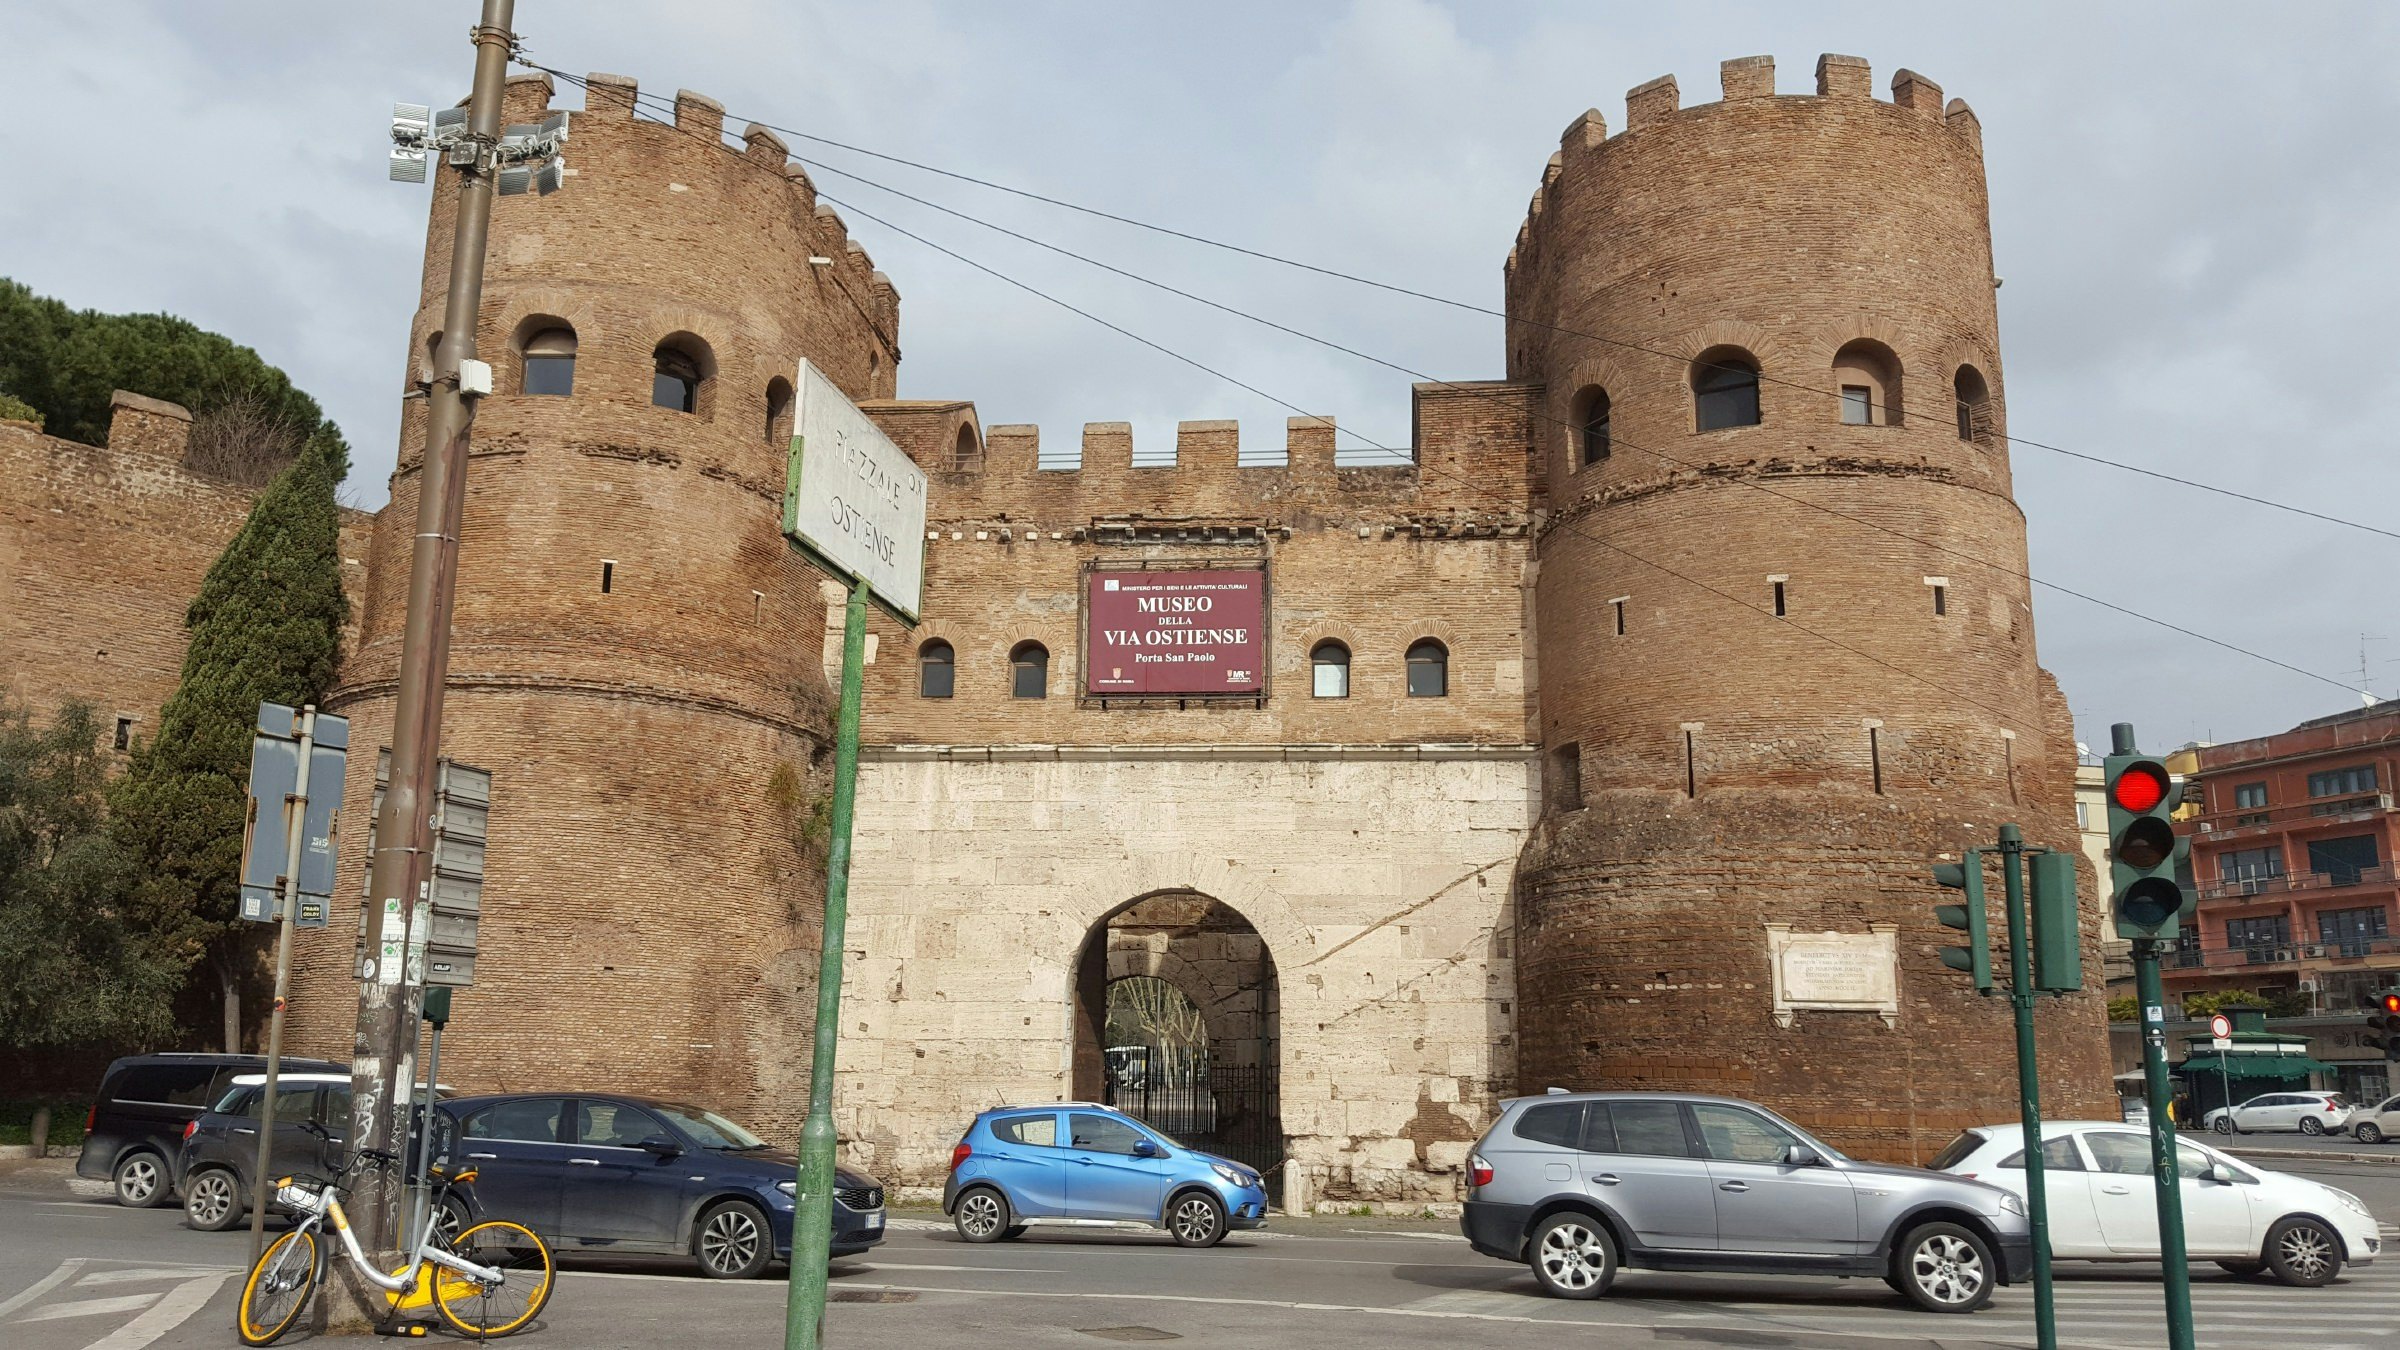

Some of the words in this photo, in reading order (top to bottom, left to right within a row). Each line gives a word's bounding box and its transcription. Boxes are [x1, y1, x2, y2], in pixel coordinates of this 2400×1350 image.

[835, 430, 900, 511] PIAZZALE
[831, 495, 896, 568] OSTIENSE
[1137, 596, 1212, 613] MUSEO
[1158, 617, 1192, 625] DELLA
[1104, 630, 1141, 646] VIA
[1145, 628, 1248, 646] OSTIENSE
[1135, 653, 1163, 663] Porta
[1165, 653, 1185, 662] San
[1187, 652, 1215, 662] Paolo
